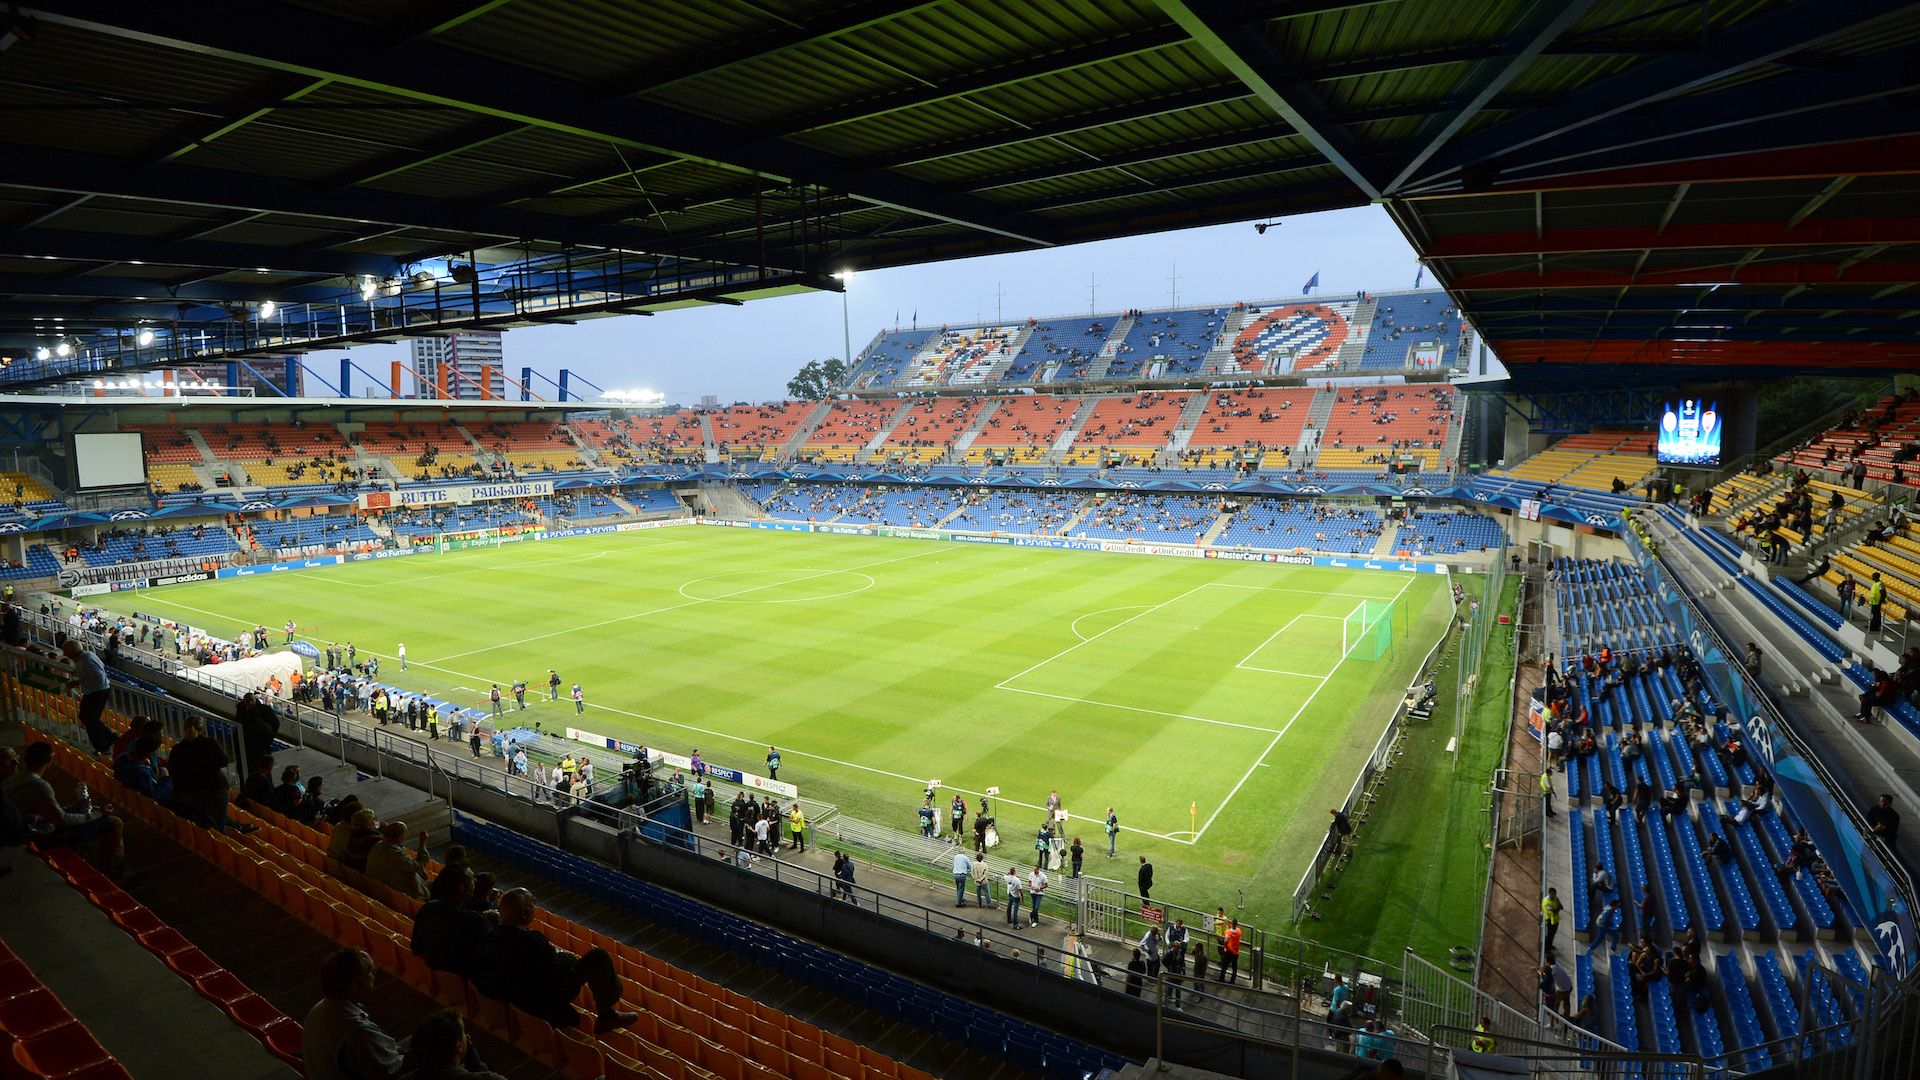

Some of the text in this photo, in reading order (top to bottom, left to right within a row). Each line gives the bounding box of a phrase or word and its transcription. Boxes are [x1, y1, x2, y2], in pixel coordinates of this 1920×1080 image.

[401, 483, 548, 504] BUTTE PAILLADE 91
[1111, 544, 1146, 553] UniCredit
[1158, 547, 1195, 557] UniCredit
[376, 551, 387, 559] Go
[1218, 550, 1262, 562] MasterCard
[1277, 554, 1311, 565] Maestro
[177, 573, 208, 583] adidas
[711, 768, 734, 779] RESPECT
